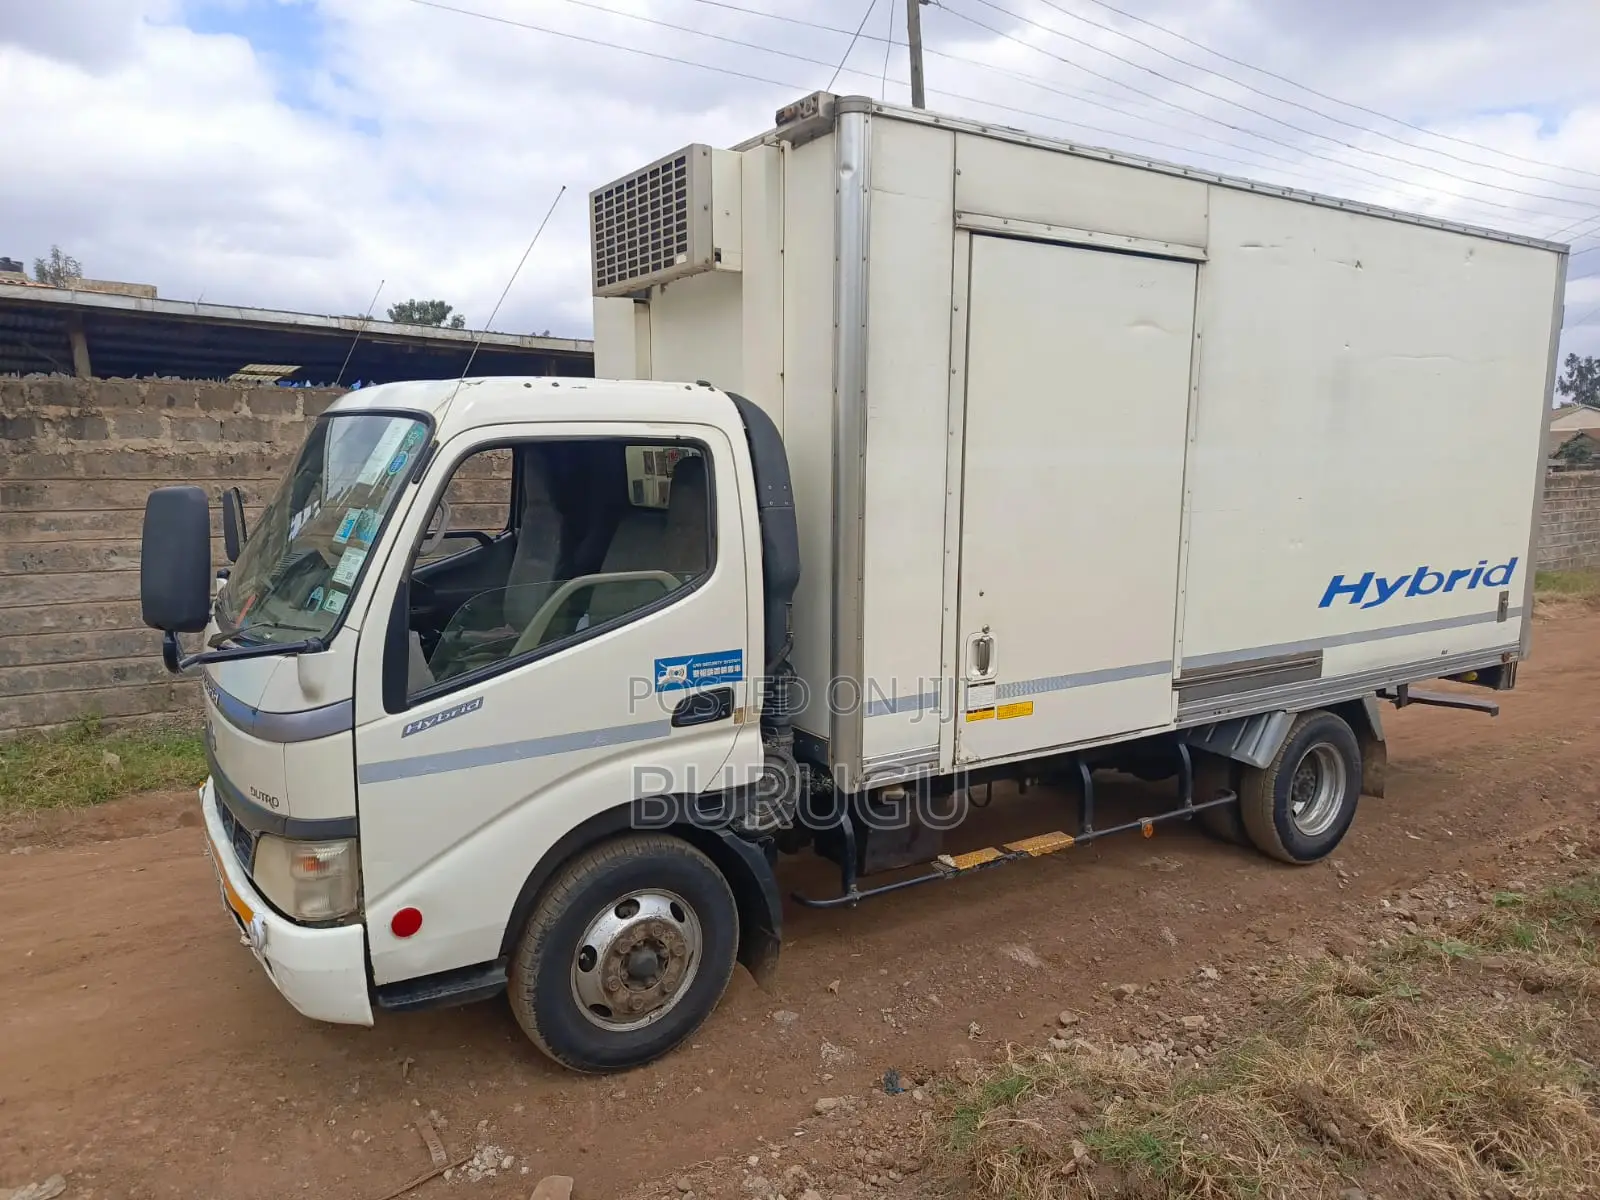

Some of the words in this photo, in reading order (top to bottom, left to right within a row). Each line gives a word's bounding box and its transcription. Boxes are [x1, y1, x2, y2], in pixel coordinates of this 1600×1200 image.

[1317, 556, 1519, 609] Hybrid
[405, 699, 481, 734] Hybrid
[249, 785, 280, 810] DUTRO
